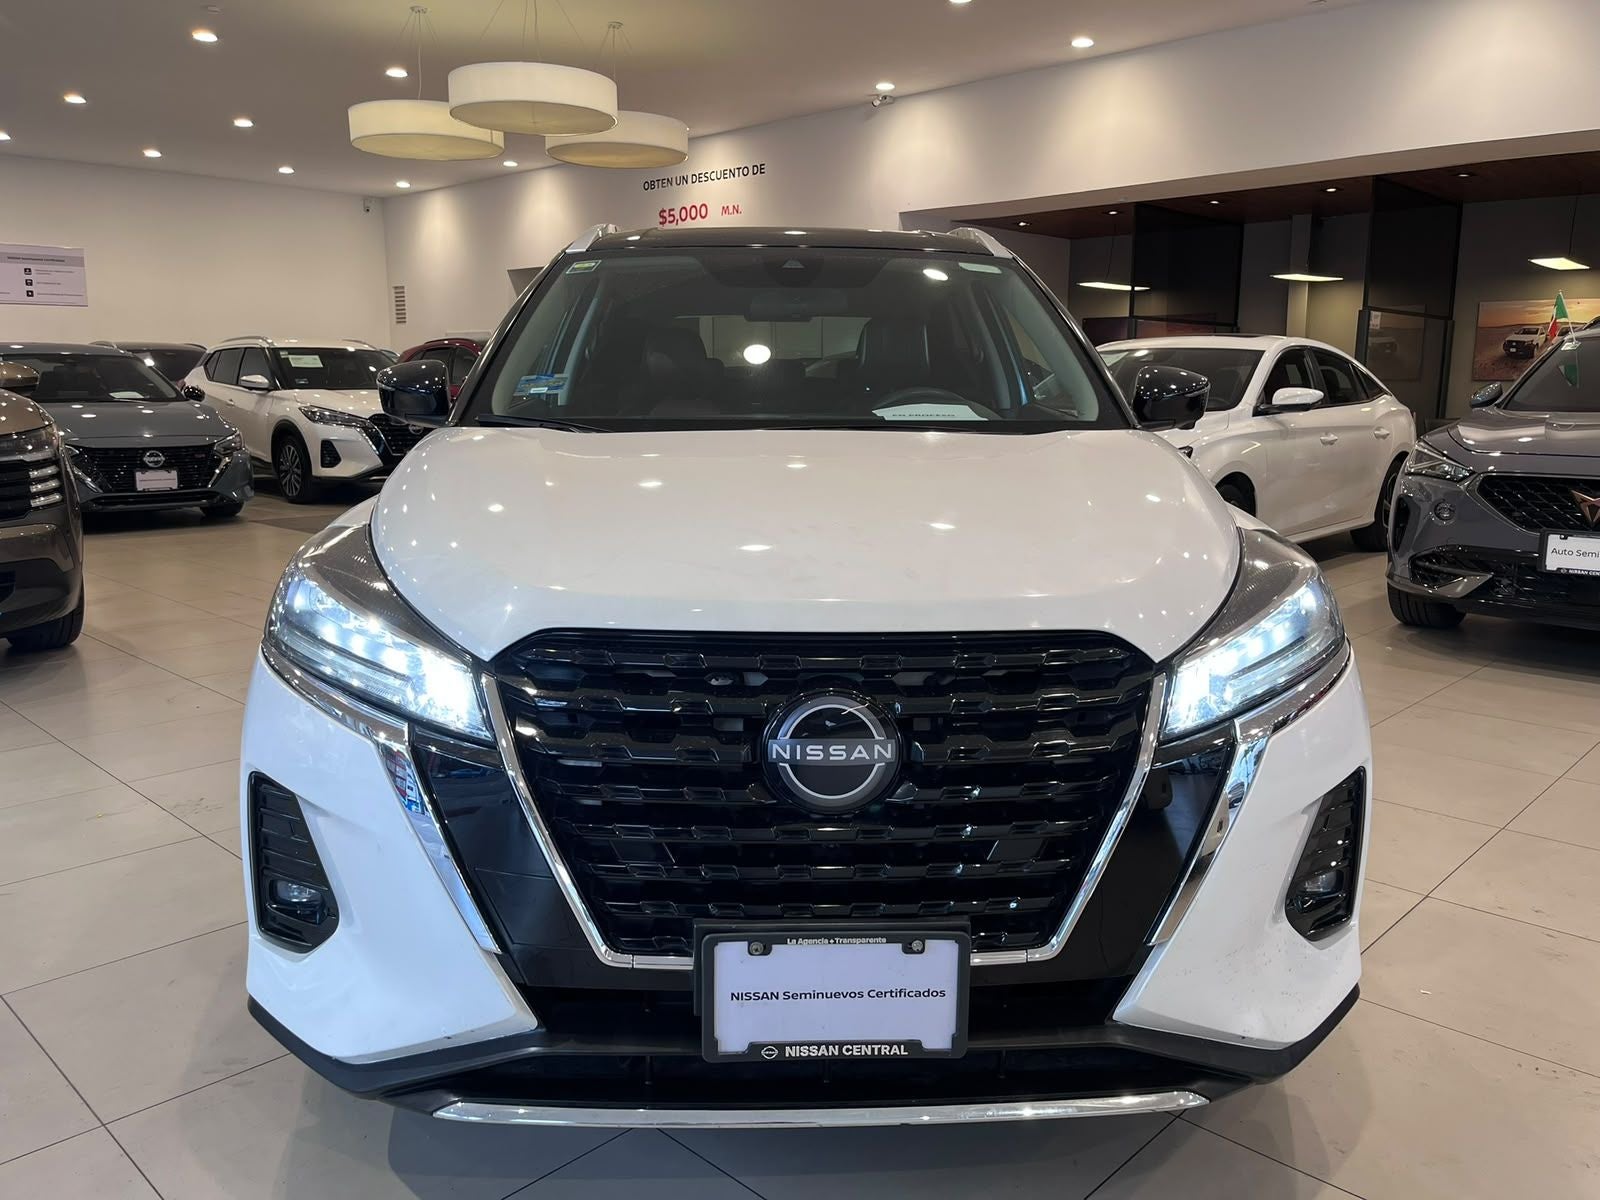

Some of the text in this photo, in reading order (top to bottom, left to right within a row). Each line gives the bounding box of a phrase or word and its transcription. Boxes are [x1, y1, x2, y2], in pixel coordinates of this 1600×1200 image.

[643, 163, 766, 191] OBTEN UN DESCUENTO DE
[658, 203, 742, 226] $5,000 M.N.
[1551, 547, 1574, 556] Auto
[772, 743, 892, 761] NISSAN
[787, 937, 797, 945] La
[797, 937, 829, 946] Agencia
[730, 987, 946, 1001] NISSAN Seminuevos Certificados
[785, 1044, 909, 1058] NISSAN CENTRAL
